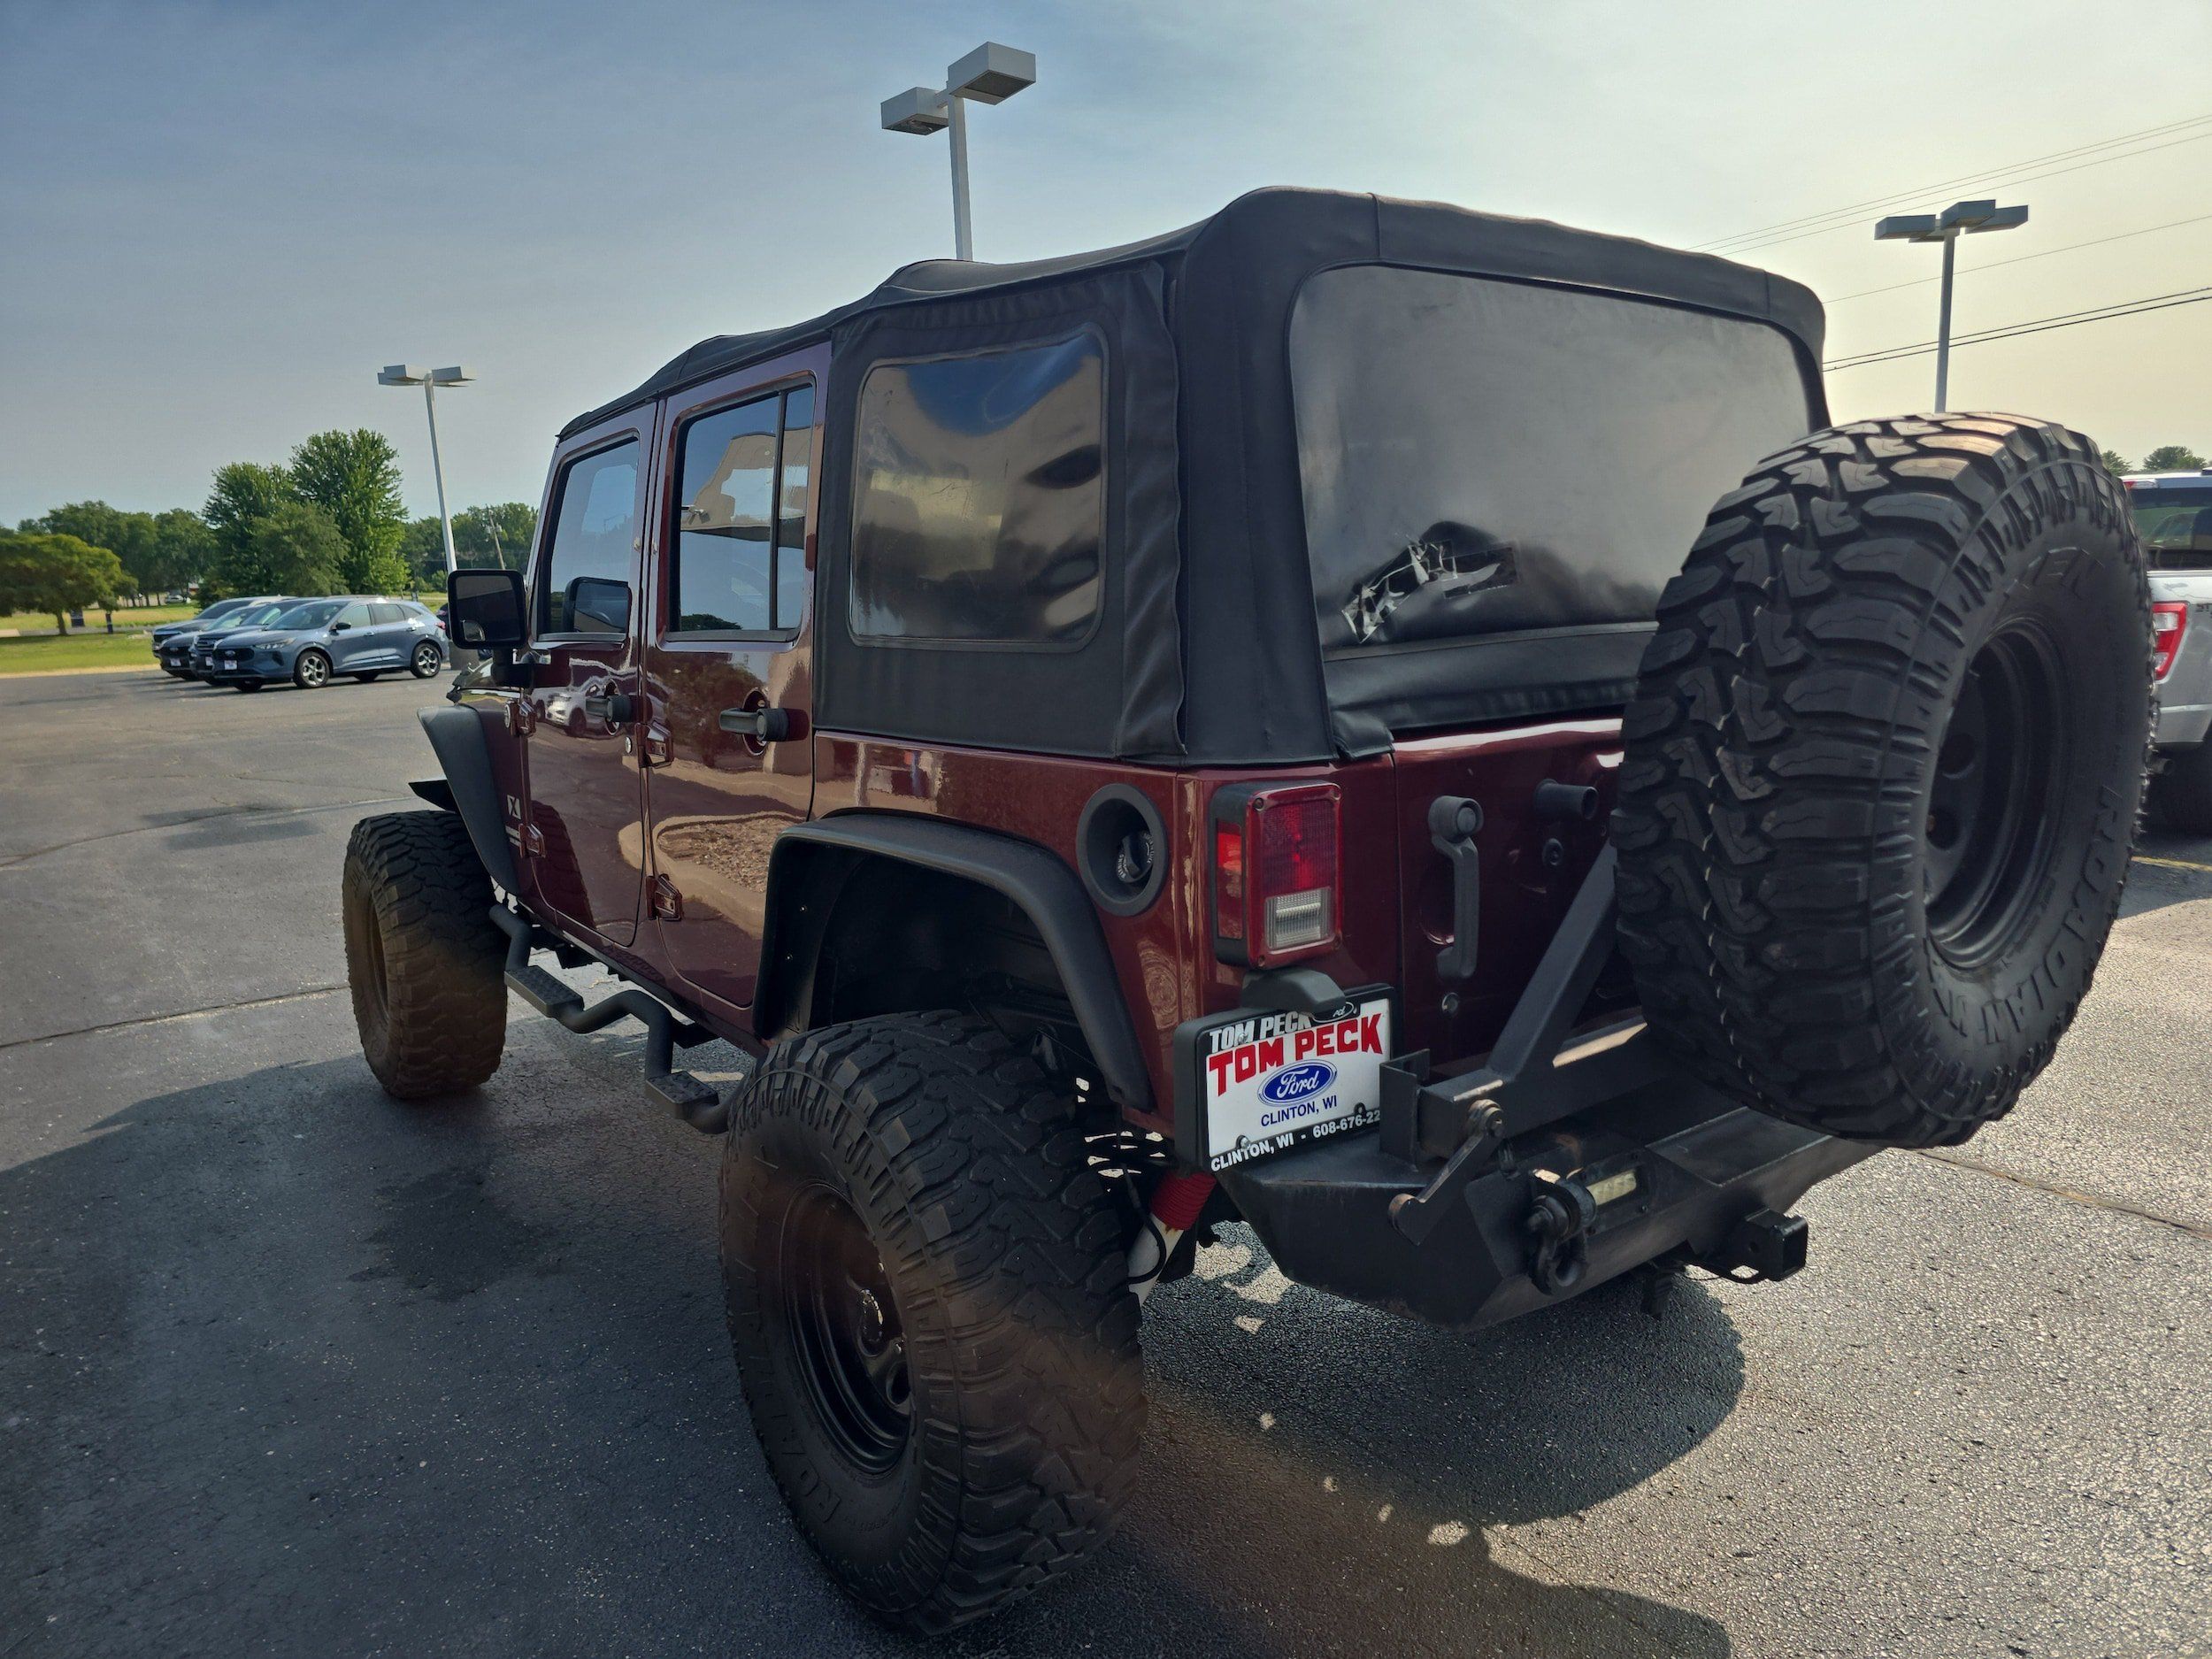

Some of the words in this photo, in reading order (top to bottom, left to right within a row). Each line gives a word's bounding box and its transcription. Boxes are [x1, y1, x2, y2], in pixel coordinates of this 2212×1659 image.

[1209, 1019, 1256, 1054] TOM
[1259, 1010, 1313, 1040] PECK
[1209, 1037, 1285, 1097] TOM
[1295, 1012, 1383, 1061] PECK
[1277, 1068, 1319, 1098] Ford
[1261, 1102, 1319, 1127] CLINTON,
[1323, 1094, 1338, 1110] WI
[1210, 1141, 1275, 1171] CLINTON,
[1276, 1132, 1294, 1148] WI
[1312, 1109, 1381, 1139] 608-676-22
